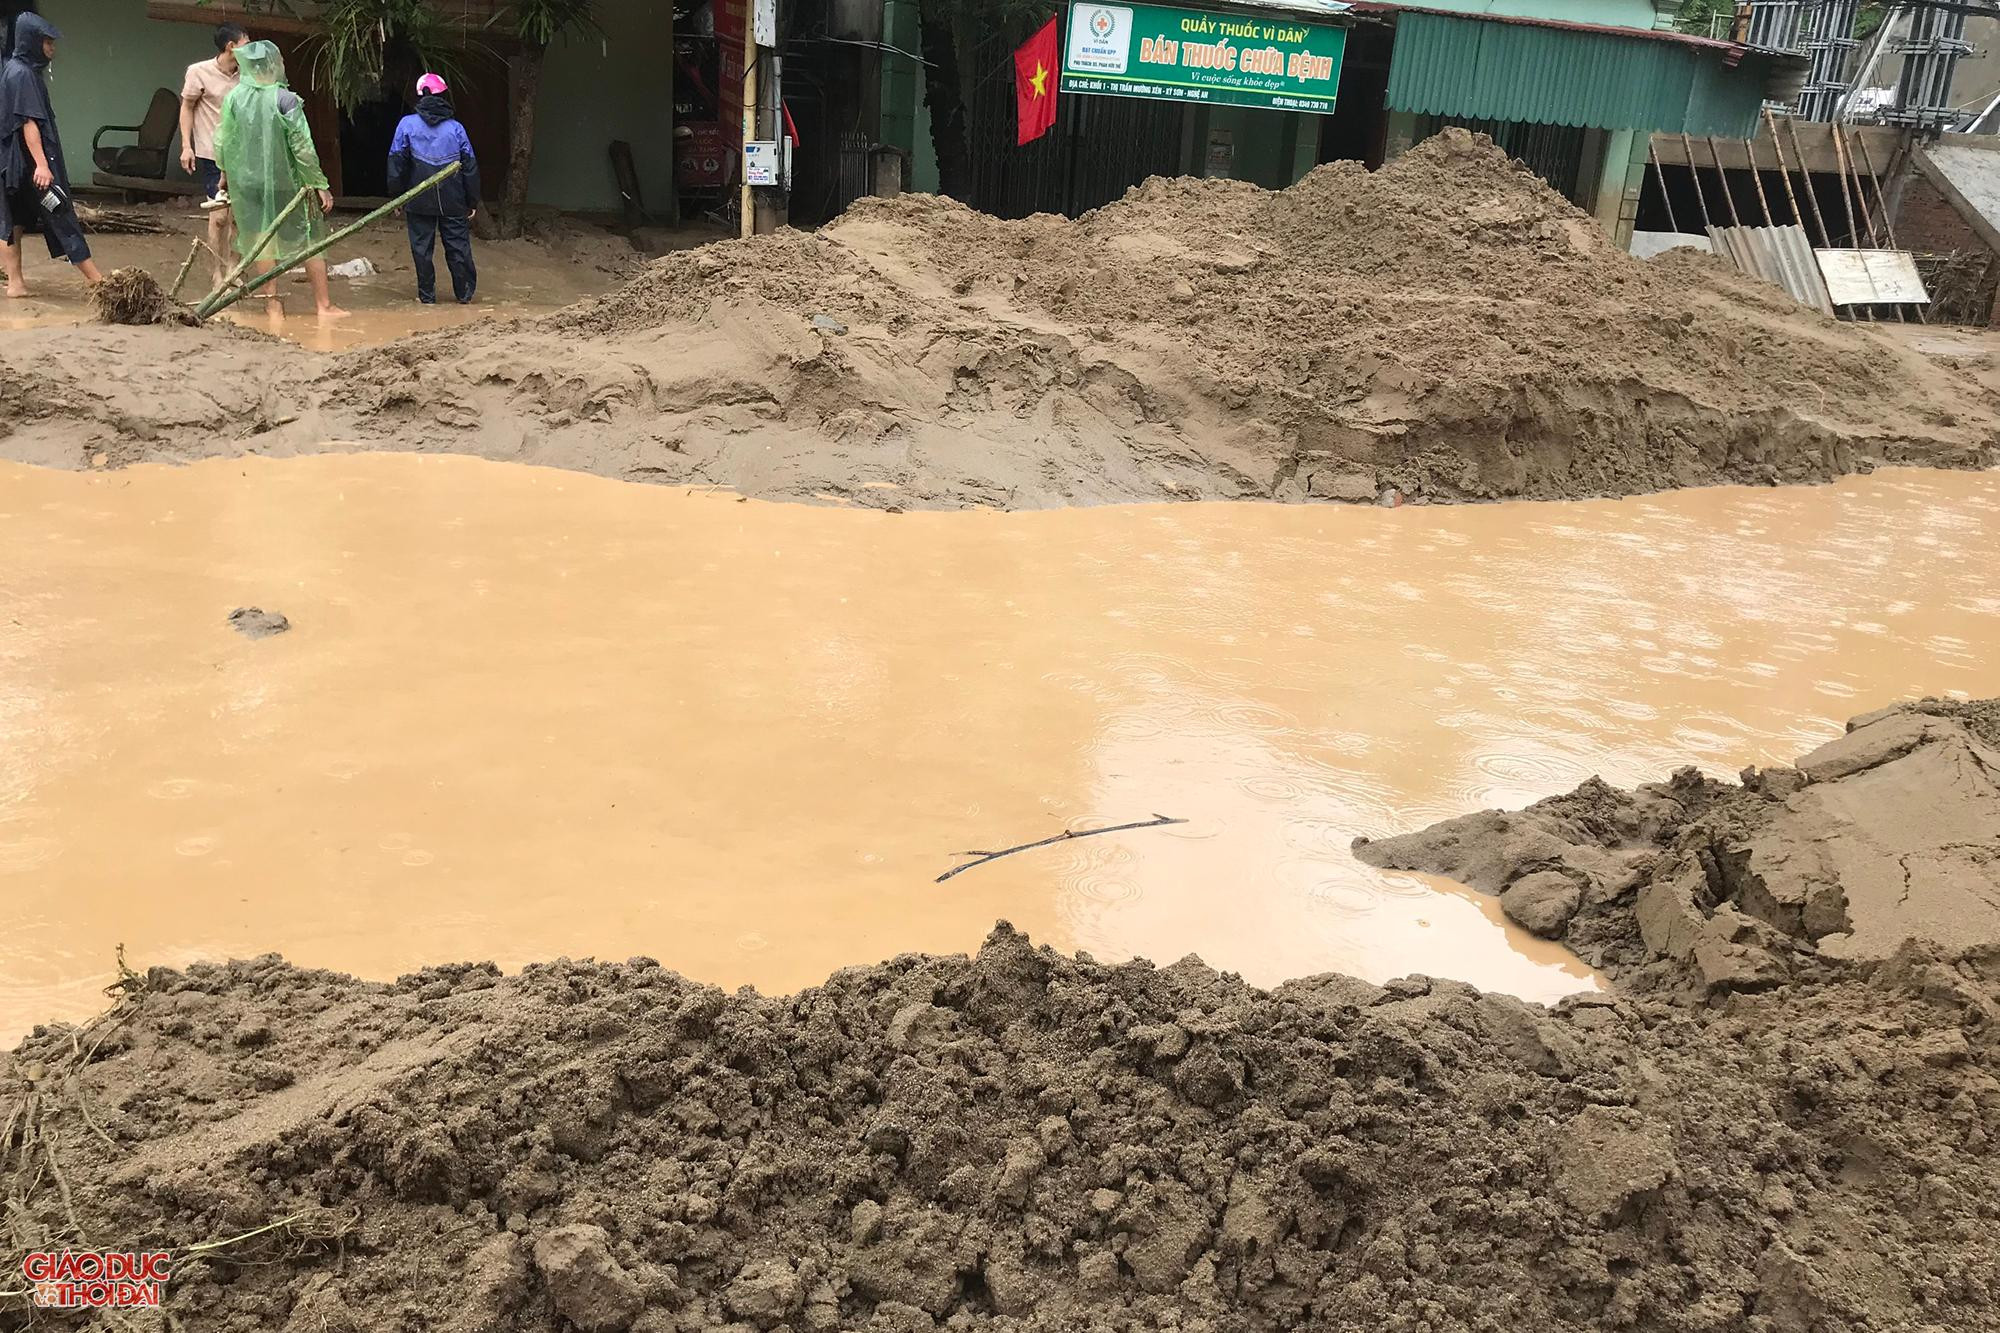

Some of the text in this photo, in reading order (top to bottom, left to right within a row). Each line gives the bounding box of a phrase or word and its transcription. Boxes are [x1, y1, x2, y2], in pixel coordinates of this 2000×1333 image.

[1181, 15, 1303, 43] QUẦY THUỐC VÌ DÂN
[1140, 34, 1332, 83] BÁN THUỐC CHỮA BỆNH
[1201, 74, 1221, 84] cuộc
[1222, 75, 1241, 87] sống
